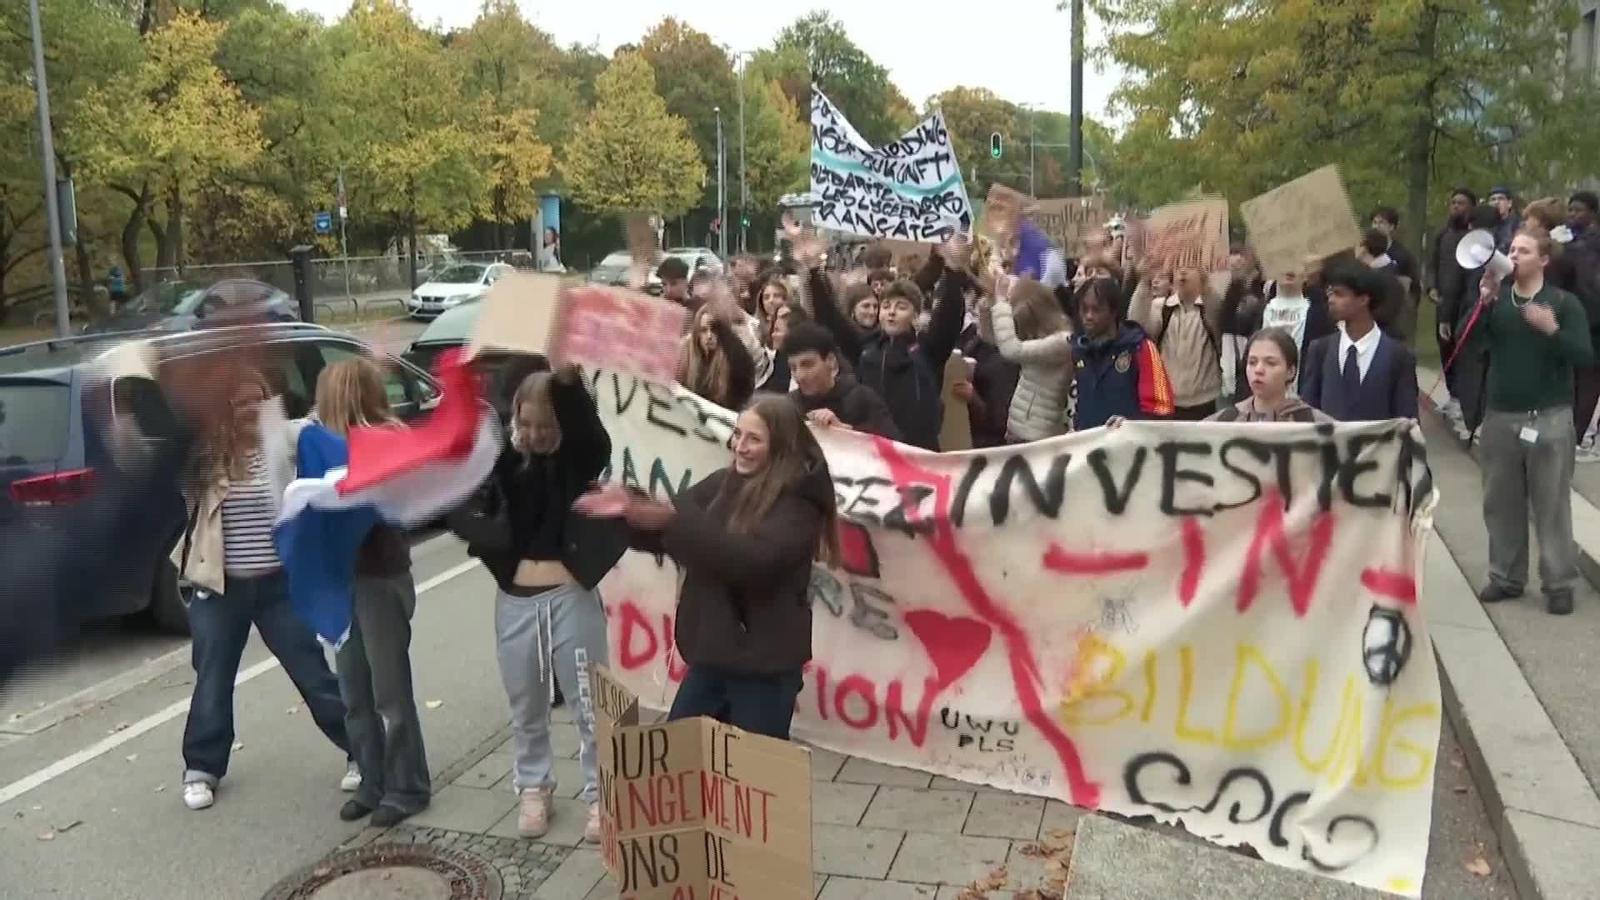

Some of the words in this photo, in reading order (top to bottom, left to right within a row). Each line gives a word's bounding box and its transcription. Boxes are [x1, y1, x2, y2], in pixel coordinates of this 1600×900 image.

[822, 185, 857, 207] LES
[941, 707, 1019, 736] UWU
[711, 726, 740, 782] LE
[957, 734, 1015, 752] PLS
[704, 831, 736, 887] DE
